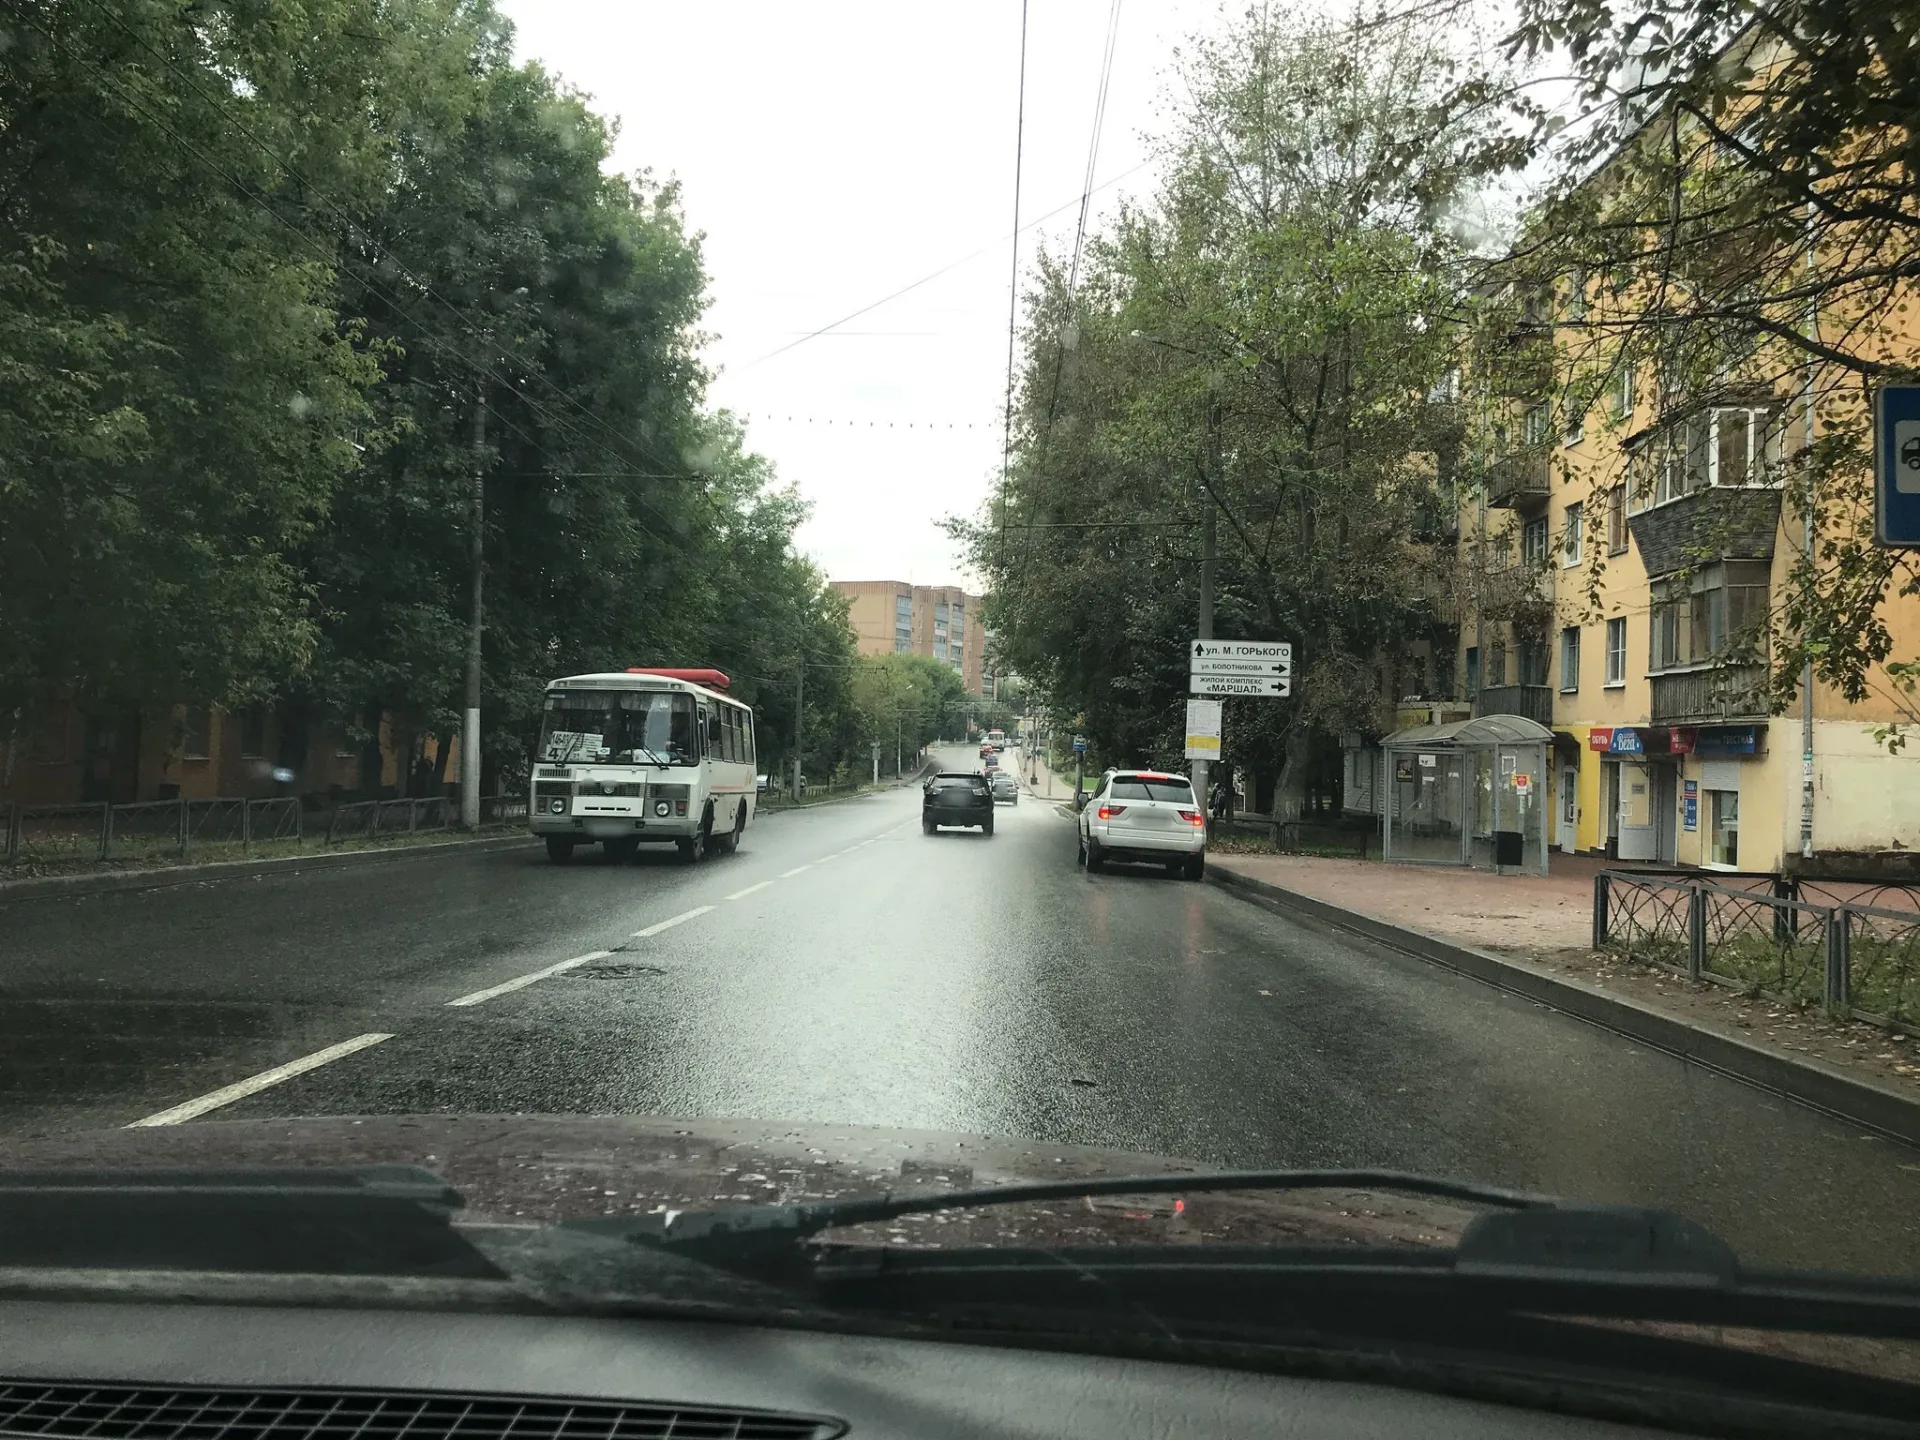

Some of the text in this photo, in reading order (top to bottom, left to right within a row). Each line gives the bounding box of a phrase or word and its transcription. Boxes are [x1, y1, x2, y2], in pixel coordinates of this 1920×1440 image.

[1206, 647, 1289, 657] ул. М. ГОРЬКОГО
[1226, 677, 1263, 685] КОМПЛЕКС
[1591, 735, 1608, 745] ОБУВЬ
